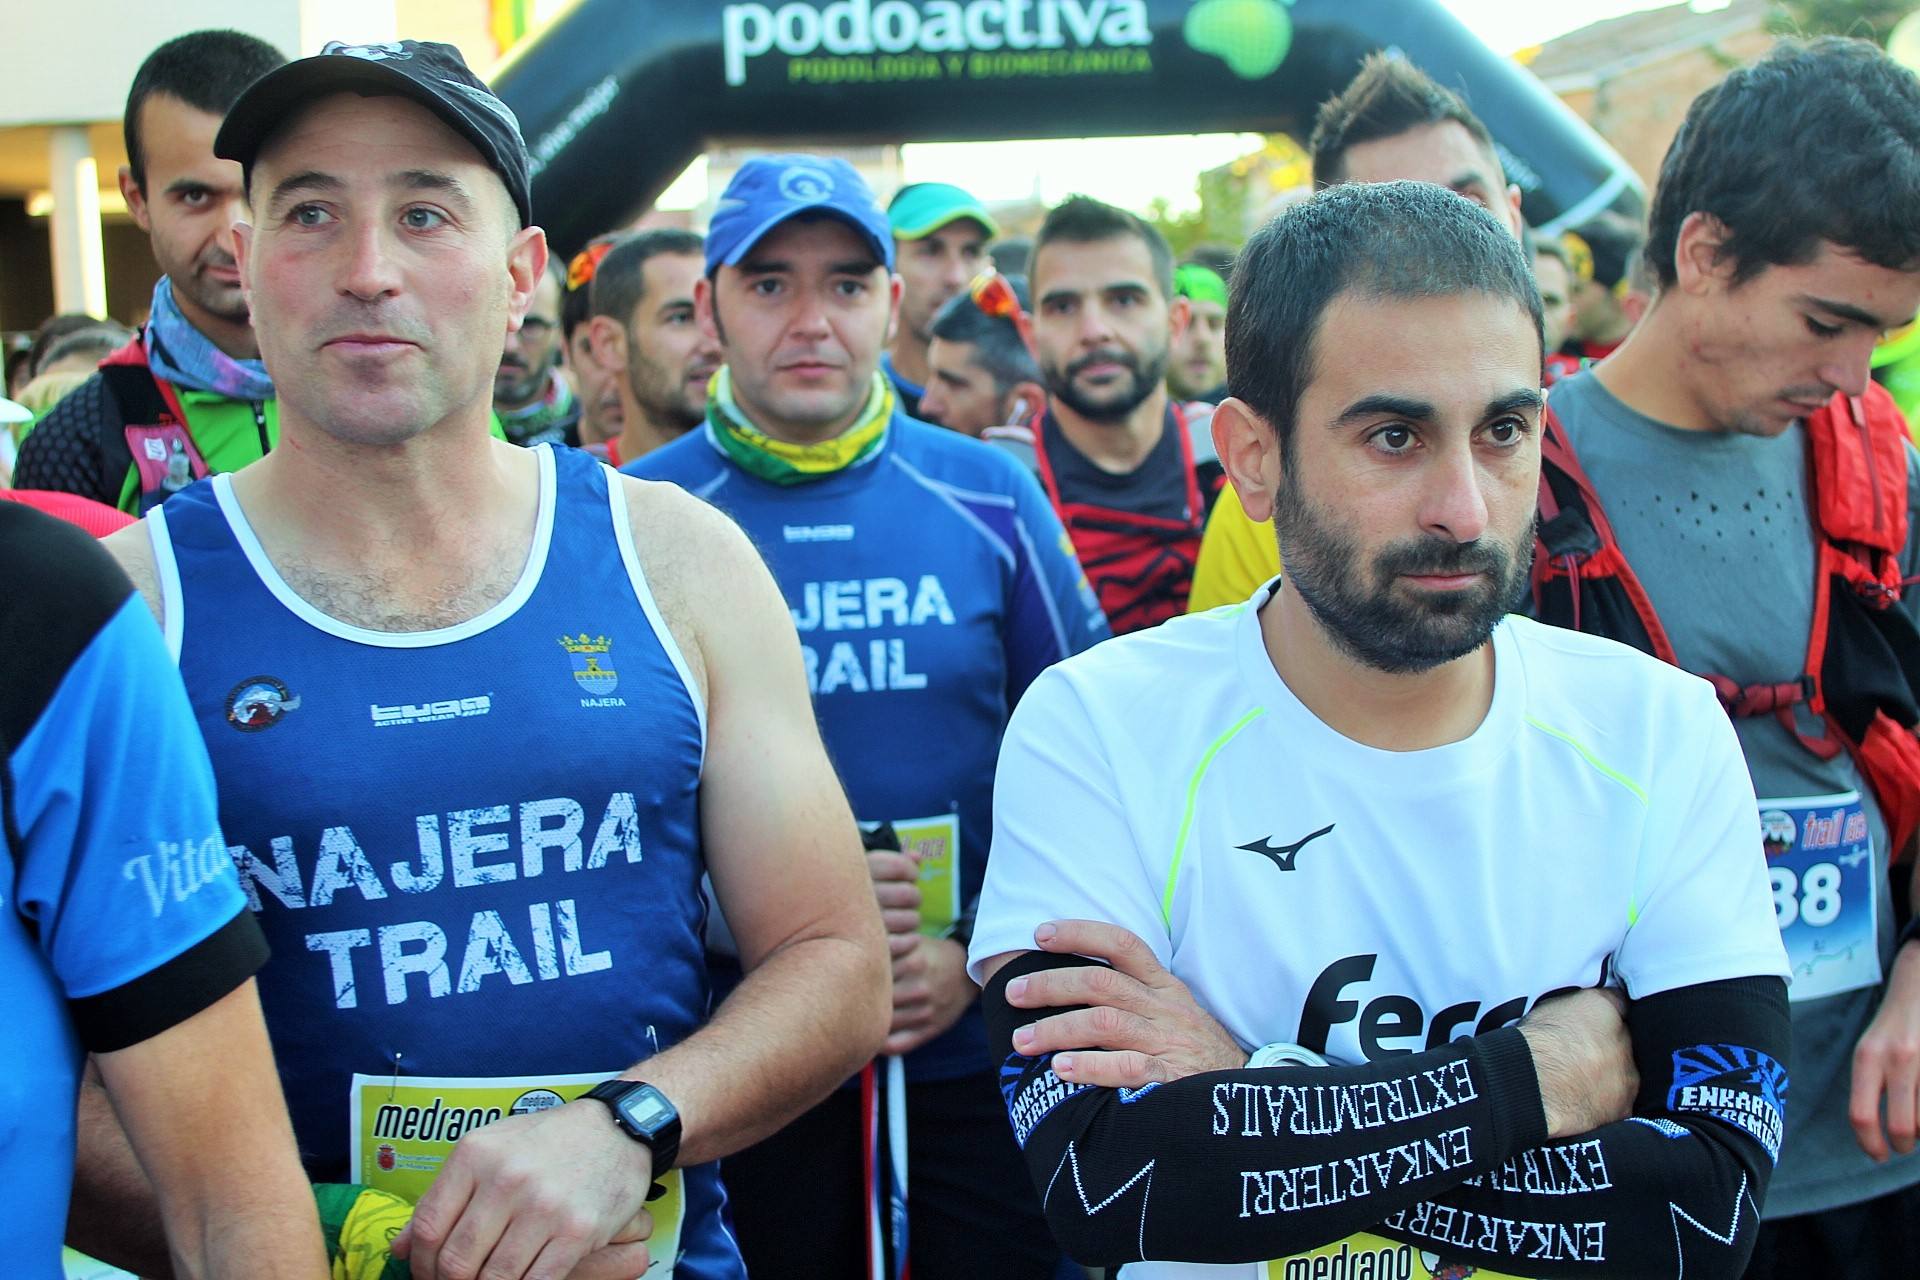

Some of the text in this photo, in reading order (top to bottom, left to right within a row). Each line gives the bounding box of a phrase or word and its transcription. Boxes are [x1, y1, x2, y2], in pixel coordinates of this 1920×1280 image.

[722, 0, 1153, 86] podoactiva
[580, 697, 626, 707] NAJERA
[227, 792, 643, 912] NAJERA
[305, 898, 612, 1009] TRAIL
[1213, 1059, 1478, 1136] EXTREMTRAILS
[1239, 1126, 1473, 1217] ENKARTERRI
